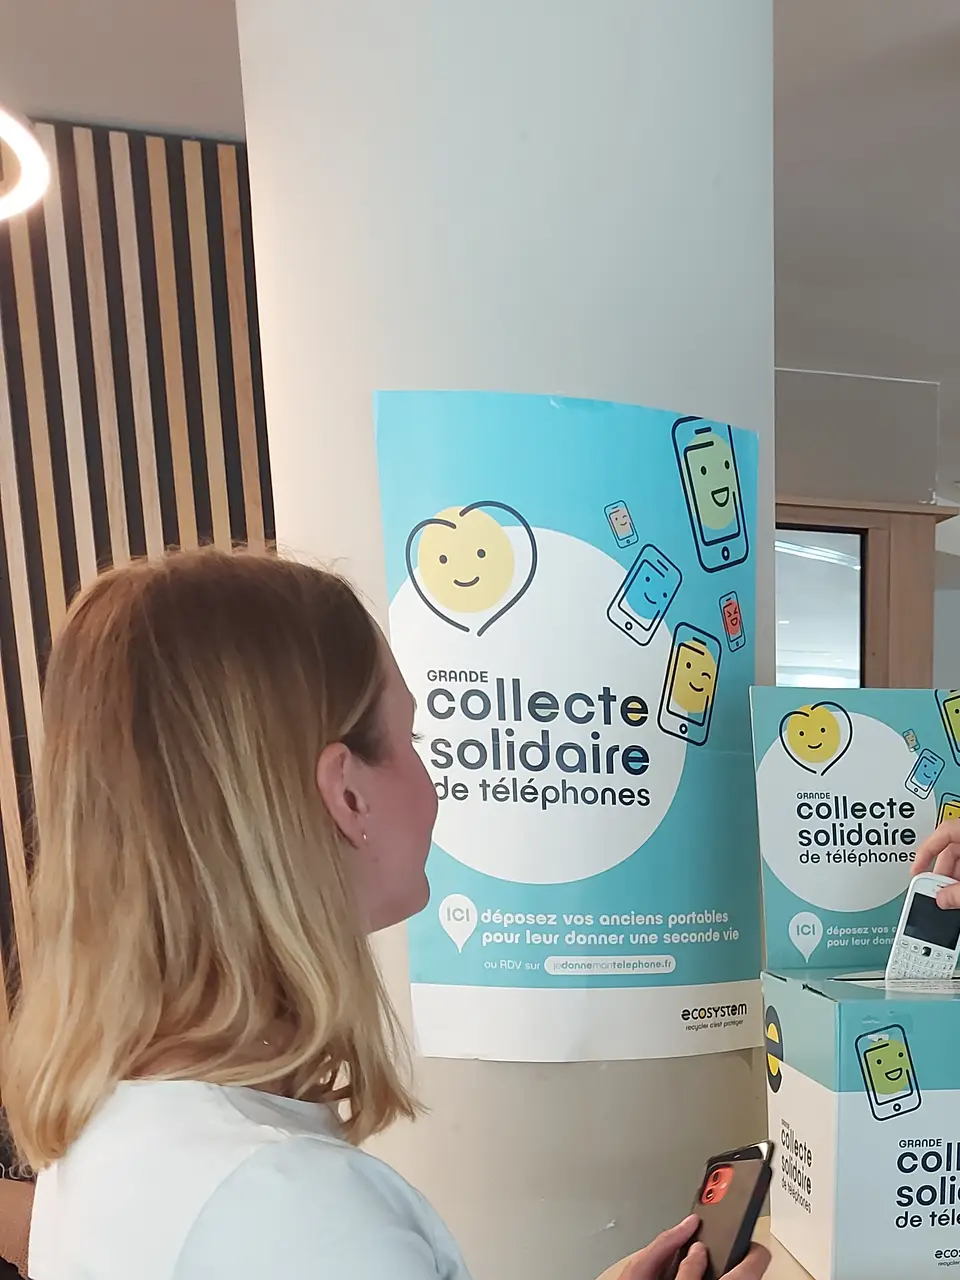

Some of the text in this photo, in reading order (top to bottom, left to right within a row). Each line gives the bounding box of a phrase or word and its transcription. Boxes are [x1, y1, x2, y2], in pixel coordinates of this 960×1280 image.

[427, 670, 489, 683] GRANDE
[427, 678, 649, 727] collecte
[430, 728, 650, 776] solidaire
[434, 775, 651, 811] de téléphones
[797, 792, 831, 800] GRANDE
[796, 795, 916, 820] collecte
[798, 822, 917, 847] solidaire
[799, 848, 917, 867] de téléphones
[446, 907, 470, 923] ICI
[480, 909, 729, 929] déposez vos anciens portables
[481, 927, 740, 947] pour leur donner une seconde vie
[797, 924, 815, 936] ICI
[826, 925, 869, 937] déposez
[871, 926, 889, 934] vos
[827, 938, 848, 950] pour
[851, 936, 870, 947] leur
[484, 961, 497, 970] ou
[500, 960, 522, 970] RDV
[525, 961, 541, 971] sur
[681, 1003, 748, 1021] ecosystem
[781, 1127, 813, 1168] collecte
[898, 1138, 943, 1149] GRANDE
[781, 1154, 812, 1195] solidaire
[895, 1211, 922, 1229] de
